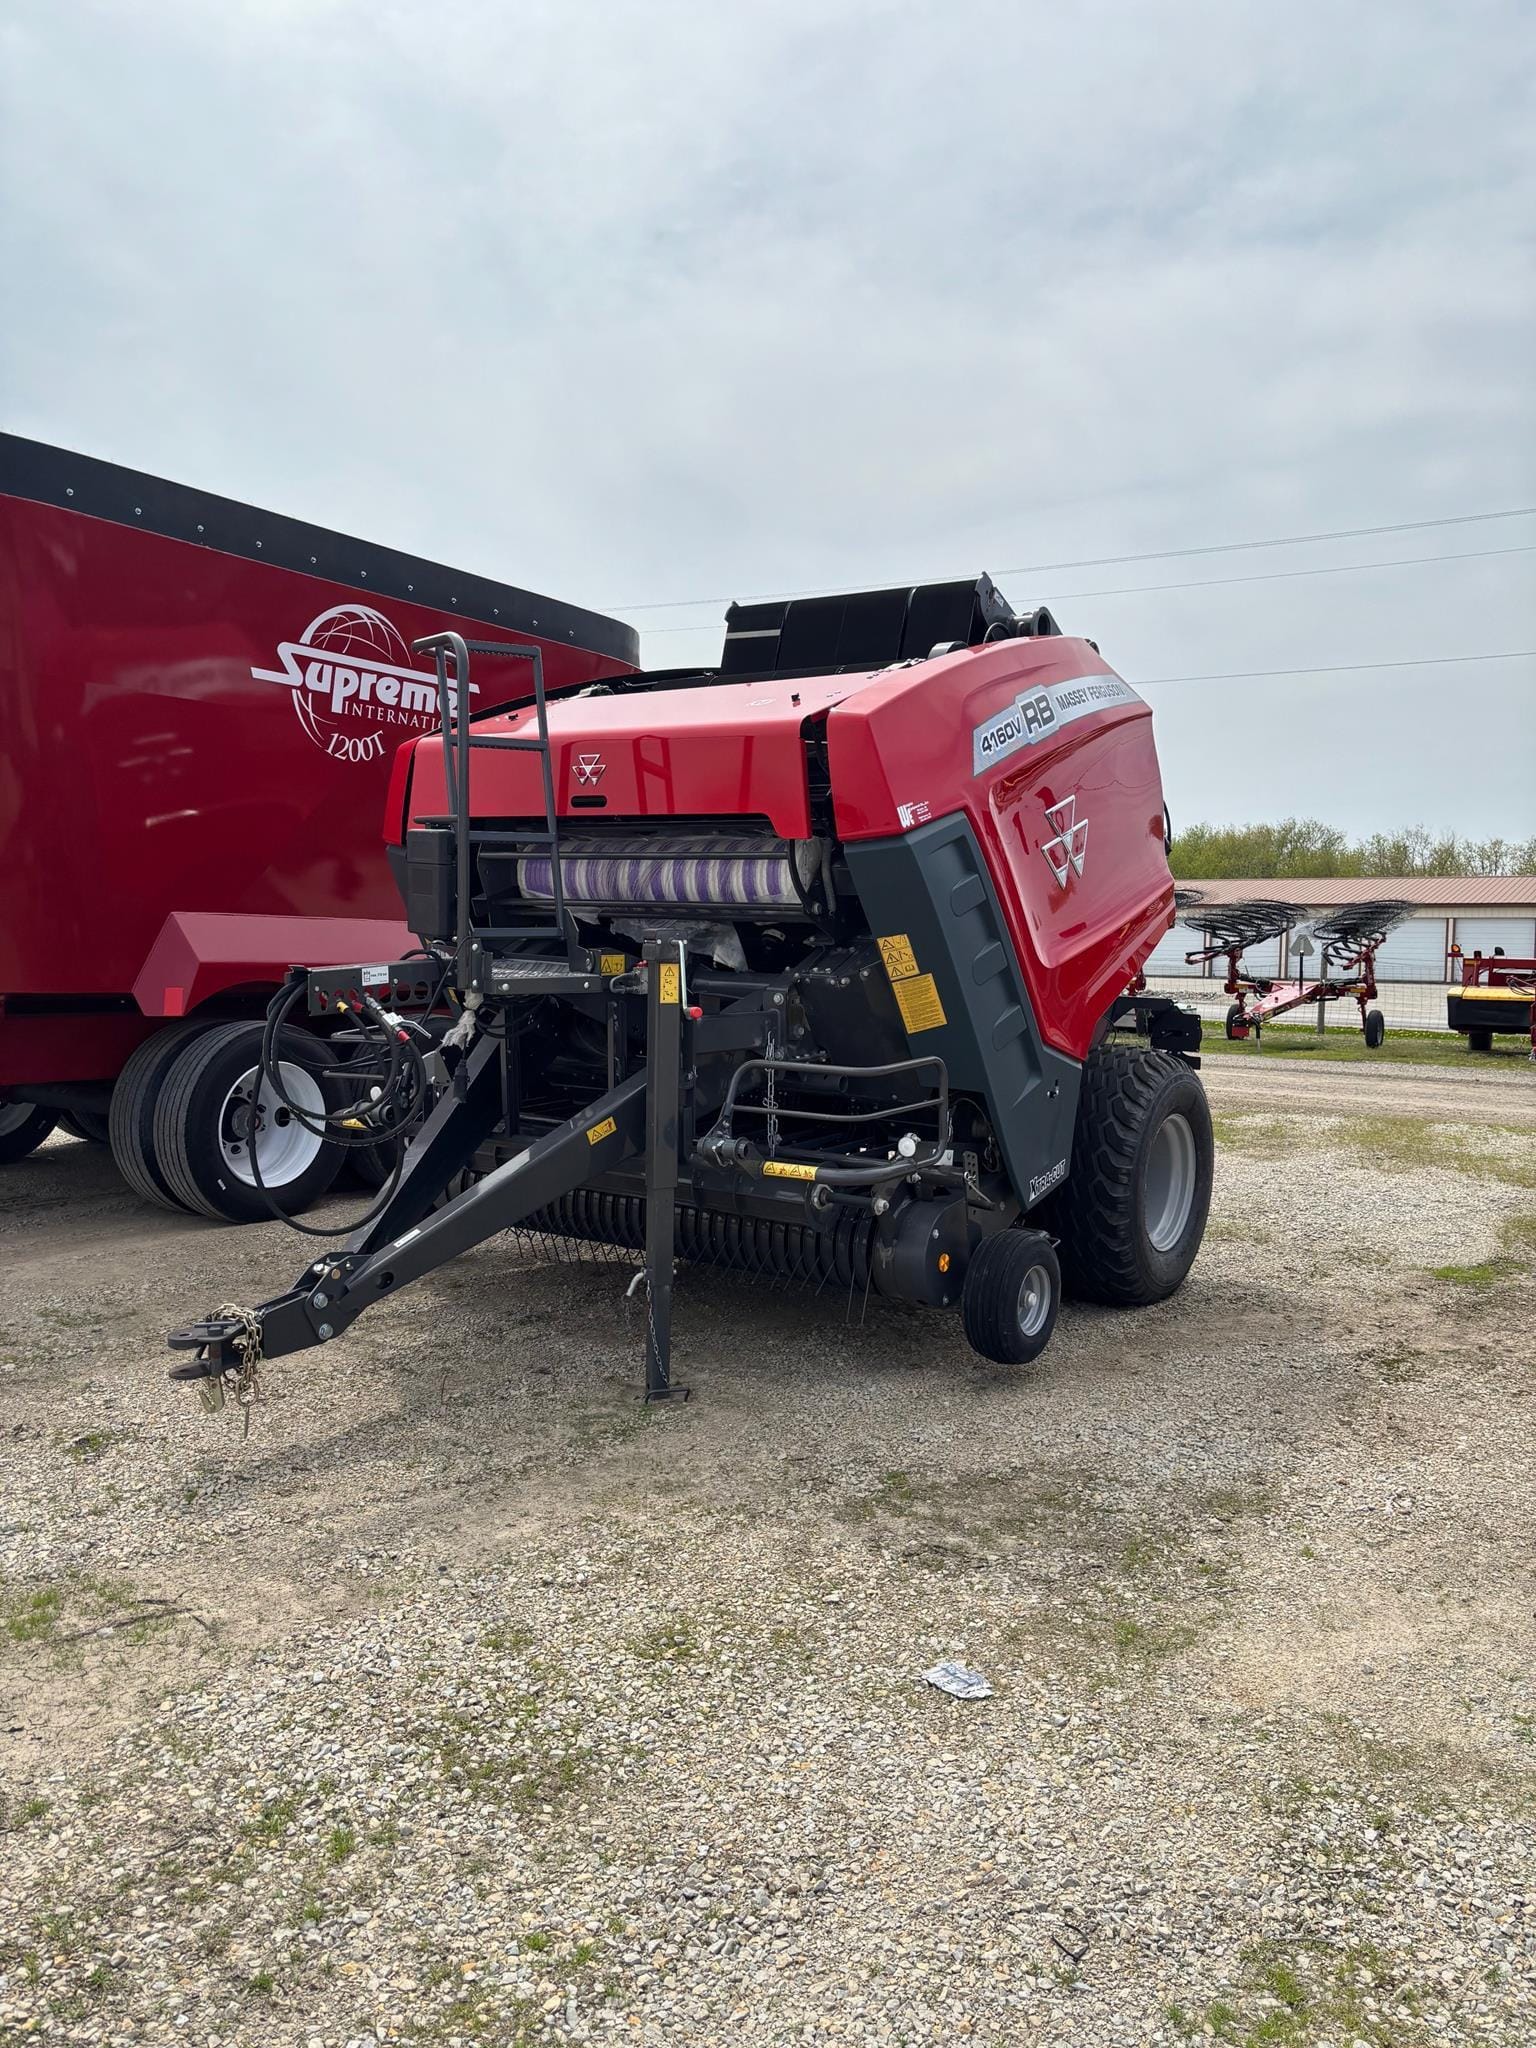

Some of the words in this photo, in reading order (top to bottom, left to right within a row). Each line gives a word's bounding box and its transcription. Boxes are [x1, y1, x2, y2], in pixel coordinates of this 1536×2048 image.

[981, 717, 1021, 753] 4160V
[1020, 694, 1055, 734] RB
[1055, 688, 1089, 711] MASSEY
[325, 730, 386, 762] 1200T
